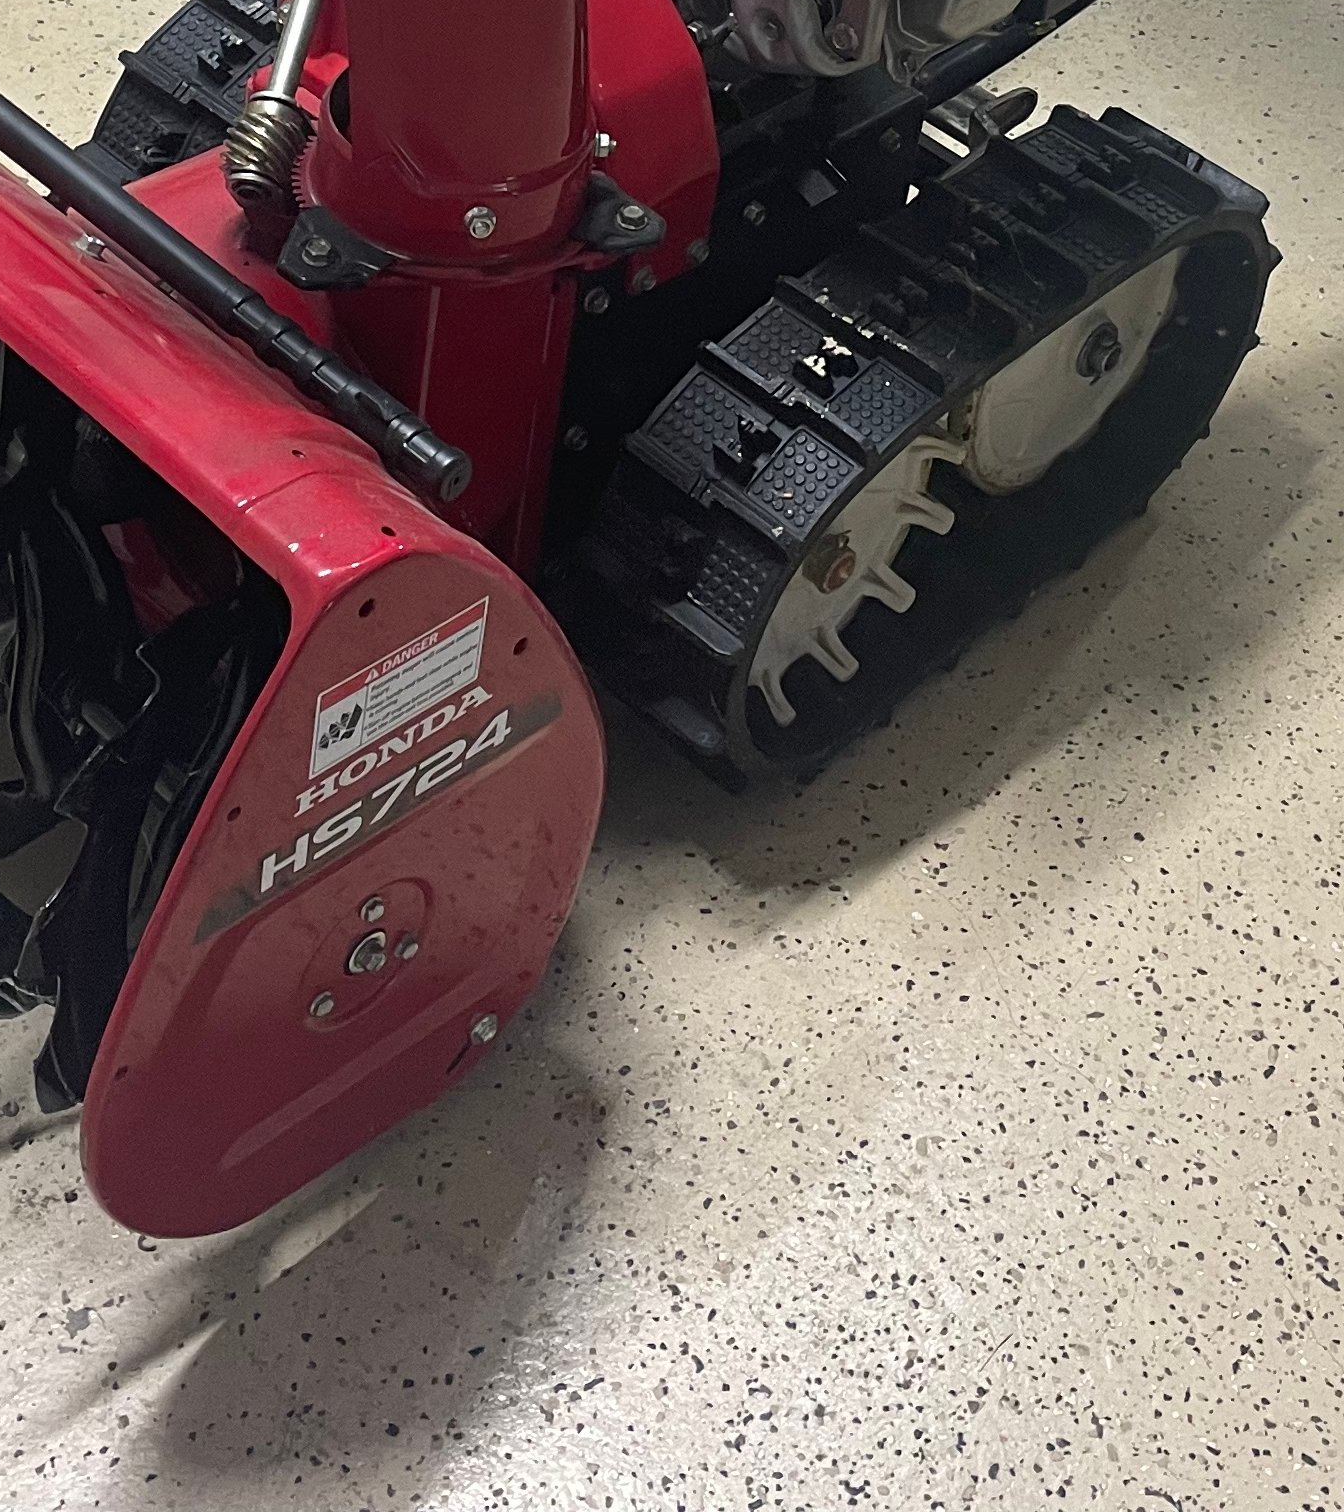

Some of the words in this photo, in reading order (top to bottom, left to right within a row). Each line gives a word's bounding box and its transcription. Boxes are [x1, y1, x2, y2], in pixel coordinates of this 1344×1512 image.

[381, 632, 438, 674] DANGER
[259, 709, 513, 894] HS724
[293, 684, 494, 818] HONDA
